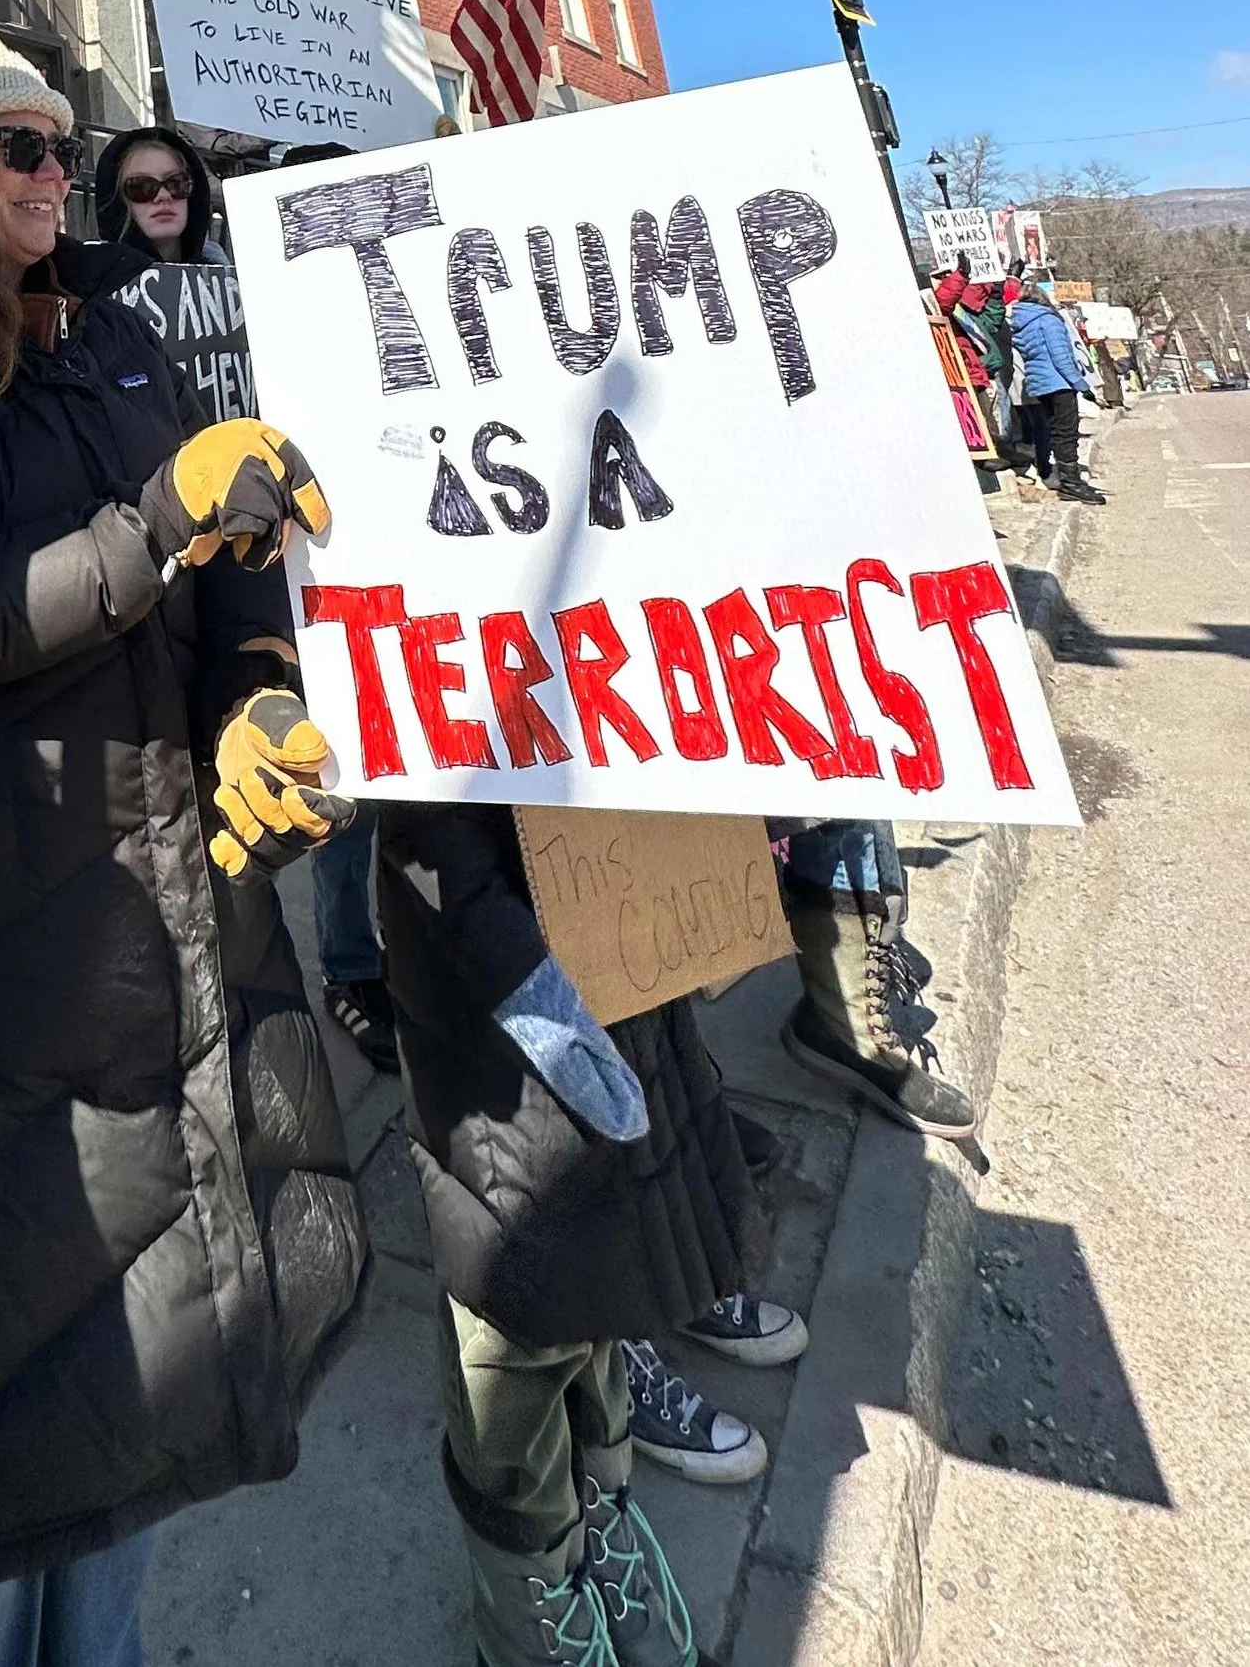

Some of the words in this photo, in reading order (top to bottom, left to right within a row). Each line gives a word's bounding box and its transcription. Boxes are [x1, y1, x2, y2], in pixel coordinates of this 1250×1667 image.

[310, 3, 354, 33] WAR
[190, 21, 217, 38] TO
[235, 24, 287, 45] LIVE
[300, 39, 332, 56] IN
[349, 48, 370, 66] AN
[195, 51, 392, 106] AUTHORITARIAN
[255, 94, 366, 132] REGIME.
[931, 213, 947, 229] NO
[951, 210, 984, 226] KINGS
[939, 233, 952, 246] NO
[955, 228, 987, 243] WARS
[178, 269, 244, 340] AND
[588, 408, 675, 530] A
[301, 557, 1034, 796] TERRORIST
